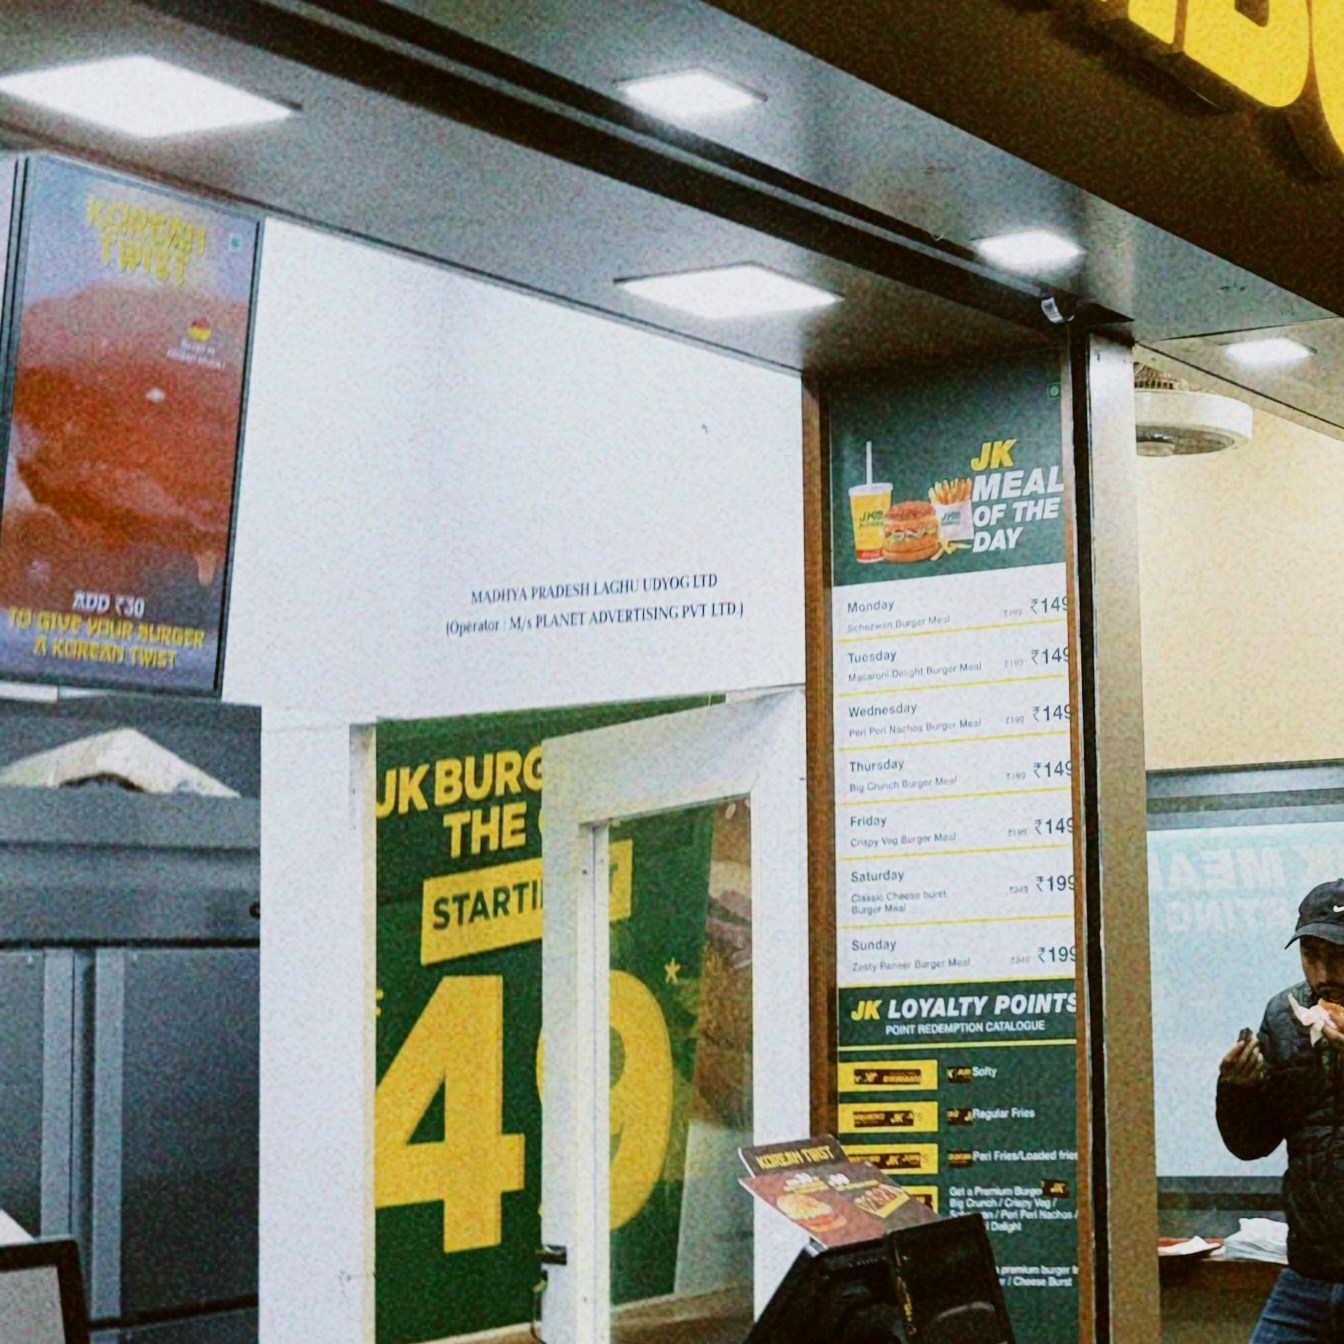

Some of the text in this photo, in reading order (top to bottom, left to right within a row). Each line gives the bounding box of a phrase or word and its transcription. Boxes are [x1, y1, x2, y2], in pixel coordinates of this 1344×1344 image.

[85, 193, 206, 256] KOREAN
[101, 234, 190, 286] TWIST
[970, 438, 1017, 472] JK
[971, 465, 1064, 503] MEAL
[973, 497, 1061, 528] OF THE
[972, 527, 1024, 553] DAY
[471, 572, 718, 605] MADHYA PRADESH LAGHU UDYOG LTD
[72, 590, 146, 619] ADD ₹30
[847, 599, 895, 614] Monday
[8, 606, 206, 649] TO GIVE YOUR BURGER
[446, 615, 500, 638] (Operator
[510, 615, 532, 633] M/s
[536, 611, 587, 629] PLANET
[588, 605, 679, 626] ADVERTISING
[682, 602, 706, 620] PVT
[847, 614, 950, 634] Schezwan Burger Meal
[33, 635, 178, 671] A KOREAN TWIST
[848, 650, 897, 665] Tuesday
[848, 662, 982, 683] Macaroni Delight Burger Meal
[849, 702, 918, 718] Wednesday
[849, 718, 982, 738] Peri Peri Nachos Burger Meal
[850, 758, 905, 774] Thursday
[434, 746, 543, 806] BURG
[849, 775, 957, 794] Big Crunch Burger Meal
[443, 802, 526, 858] THE
[850, 815, 887, 828] Friday
[850, 831, 957, 849] Crispy Veg Burger Meal
[850, 869, 905, 884] Saturday
[432, 878, 543, 931] STARTI
[851, 888, 947, 904] Classic Cheese burst
[851, 903, 907, 917] Burger Meal
[851, 938, 897, 953] Sunday
[852, 956, 971, 973] Zesty Paneer Burger Meal
[851, 992, 1077, 1022] JK LOYALTY POINTS
[885, 1019, 1046, 1036] POINT REDEMPTION CATALOGUE
[972, 1065, 998, 1079] Softy
[972, 1107, 1009, 1121] Regular
[1011, 1106, 1036, 1119] Fries
[755, 1144, 836, 1170] KOREAN TWIST
[972, 1150, 995, 1162] Peri
[949, 1185, 1043, 1198] Get a Premium Burge
[949, 1198, 965, 1210] Big
[966, 1197, 998, 1208] Crunch
[1004, 1198, 1035, 1210] Crispy
[1035, 1198, 1052, 1210] Veg
[1001, 1209, 1019, 1220] Peri
[1020, 1209, 1038, 1220] Peri
[1039, 1209, 1073, 1220] Nachos
[991, 1221, 1023, 1234] Delight
[1001, 1265, 1040, 1276] premium
[1041, 1264, 1071, 1277] burger
[1013, 1276, 1047, 1287] Cheese
[1048, 1276, 1073, 1288] Burst
